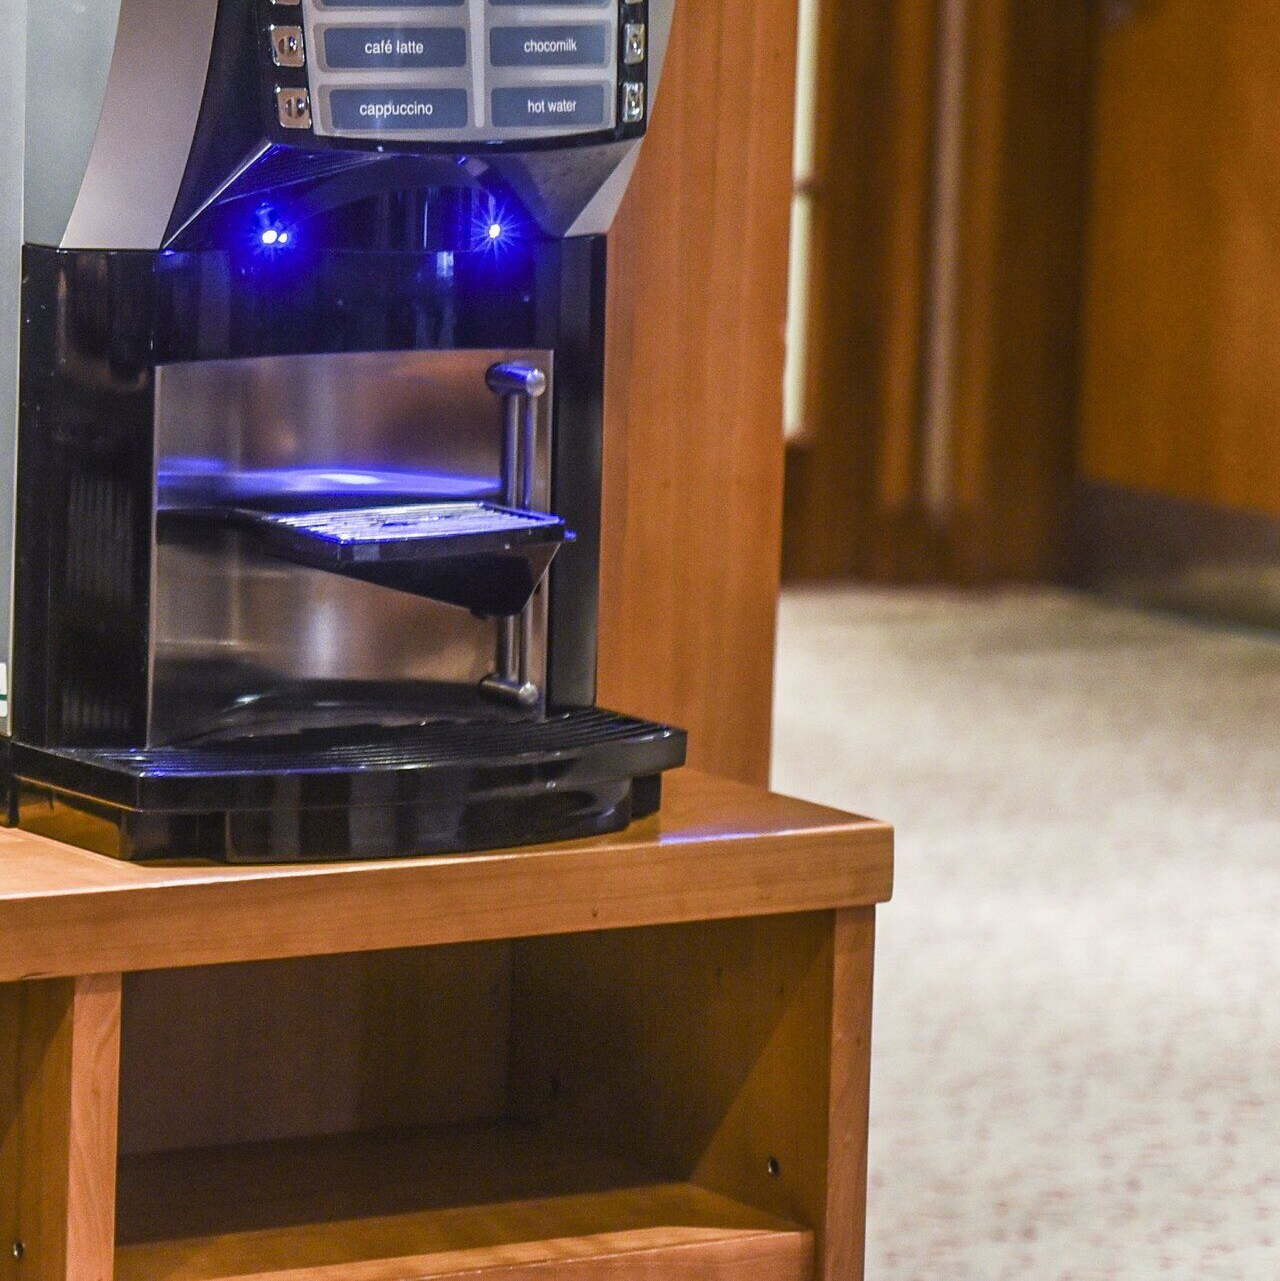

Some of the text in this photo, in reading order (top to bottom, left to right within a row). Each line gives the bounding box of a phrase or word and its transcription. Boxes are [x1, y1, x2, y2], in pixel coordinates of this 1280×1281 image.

[365, 37, 424, 55] café latte
[524, 38, 577, 54] chocomilk
[359, 100, 433, 118] cappuccino
[527, 98, 577, 113] hot water
